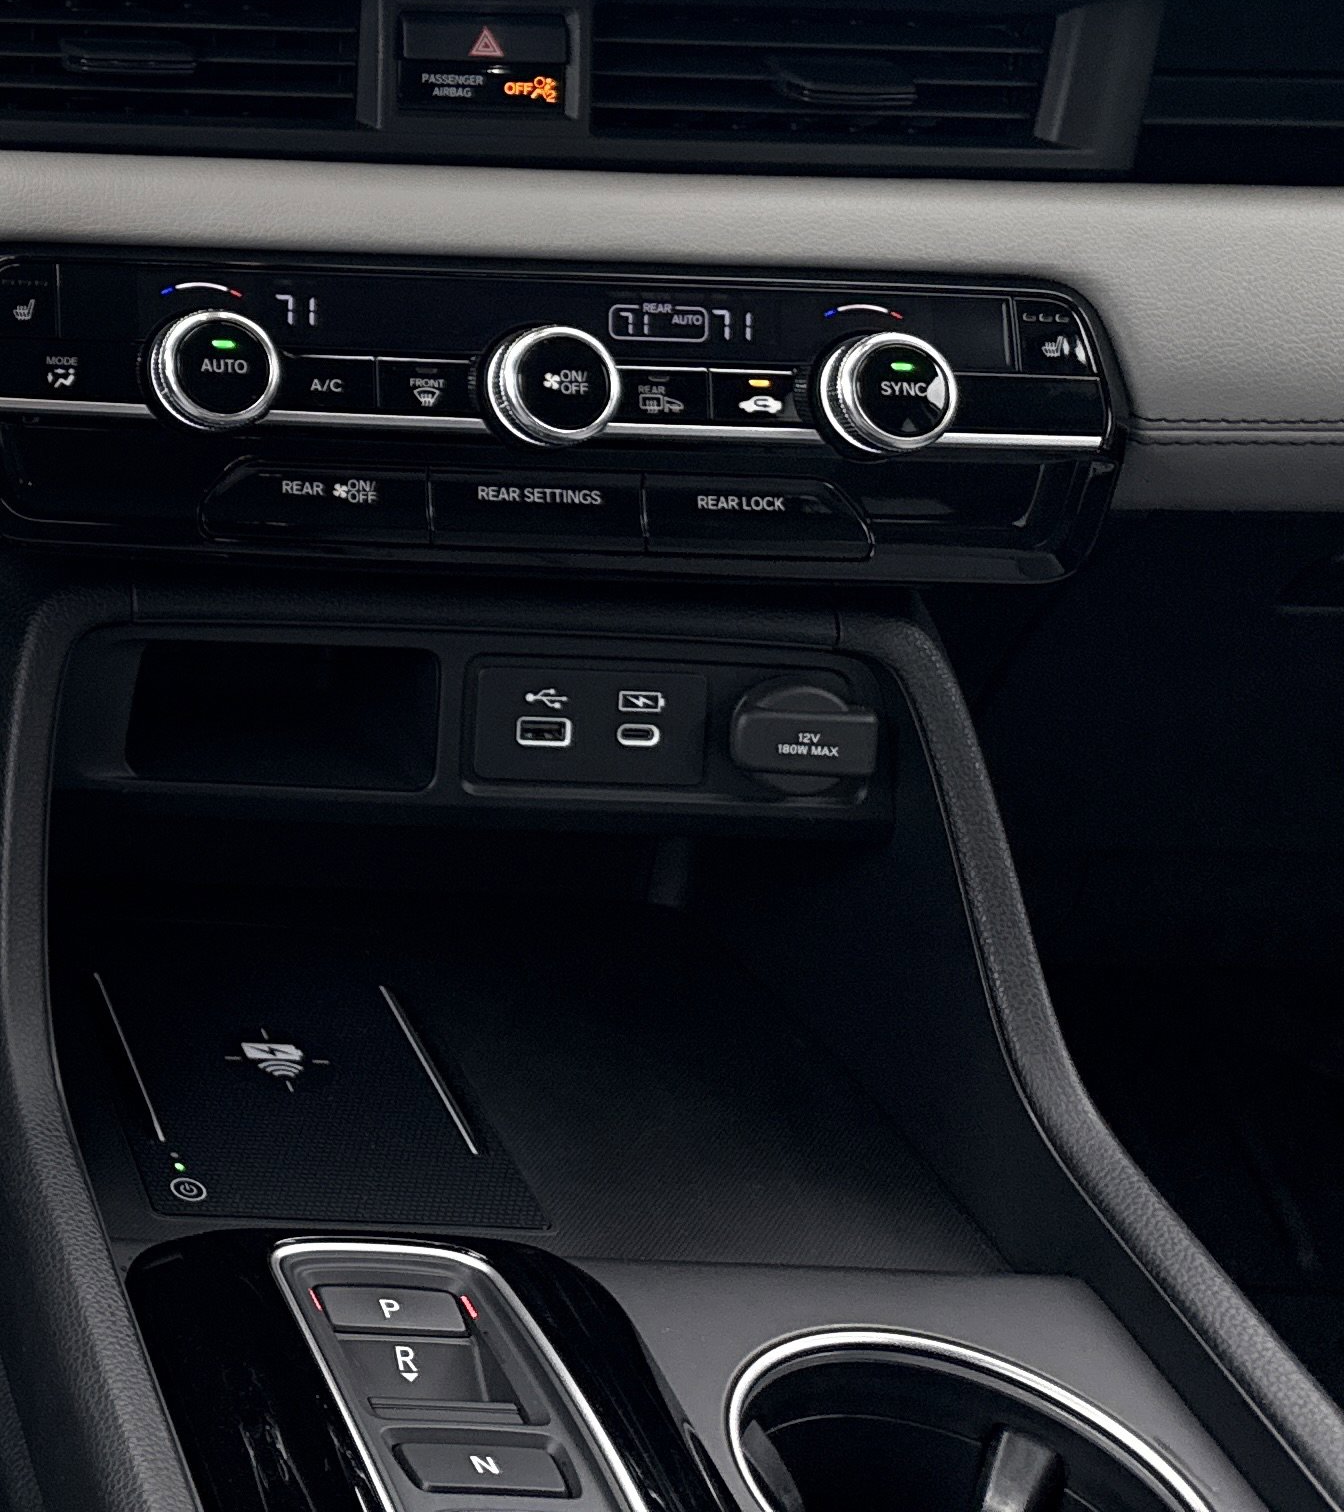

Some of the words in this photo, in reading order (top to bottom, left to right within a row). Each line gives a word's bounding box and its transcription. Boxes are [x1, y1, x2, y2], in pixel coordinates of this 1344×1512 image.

[421, 73, 484, 86] PASSENGER
[432, 87, 472, 98] AIRBAG
[503, 82, 533, 96] OFF
[275, 293, 317, 326] 71
[642, 303, 673, 313] REAR
[671, 315, 703, 325] AUTO
[712, 309, 753, 341] 71
[46, 356, 78, 367] MODE
[201, 358, 248, 375] AUTO
[409, 378, 445, 389] FRONT
[560, 370, 588, 384] ON/
[310, 378, 342, 393] A/C
[560, 382, 589, 395] OFF
[638, 384, 666, 395] REAR
[880, 381, 928, 397] SYNC
[281, 481, 323, 497] REAR
[347, 479, 376, 493] ON/
[347, 491, 378, 504] OFF
[477, 487, 520, 503] REAR
[524, 488, 601, 505] SETTINGS
[697, 495, 738, 511] REAR
[741, 496, 785, 512] LOCK
[798, 733, 821, 744] 12V
[777, 743, 809, 756] 180W
[810, 745, 839, 757] MAX
[378, 1298, 401, 1320] P
[395, 1345, 419, 1373] R
[470, 1455, 501, 1475] N
